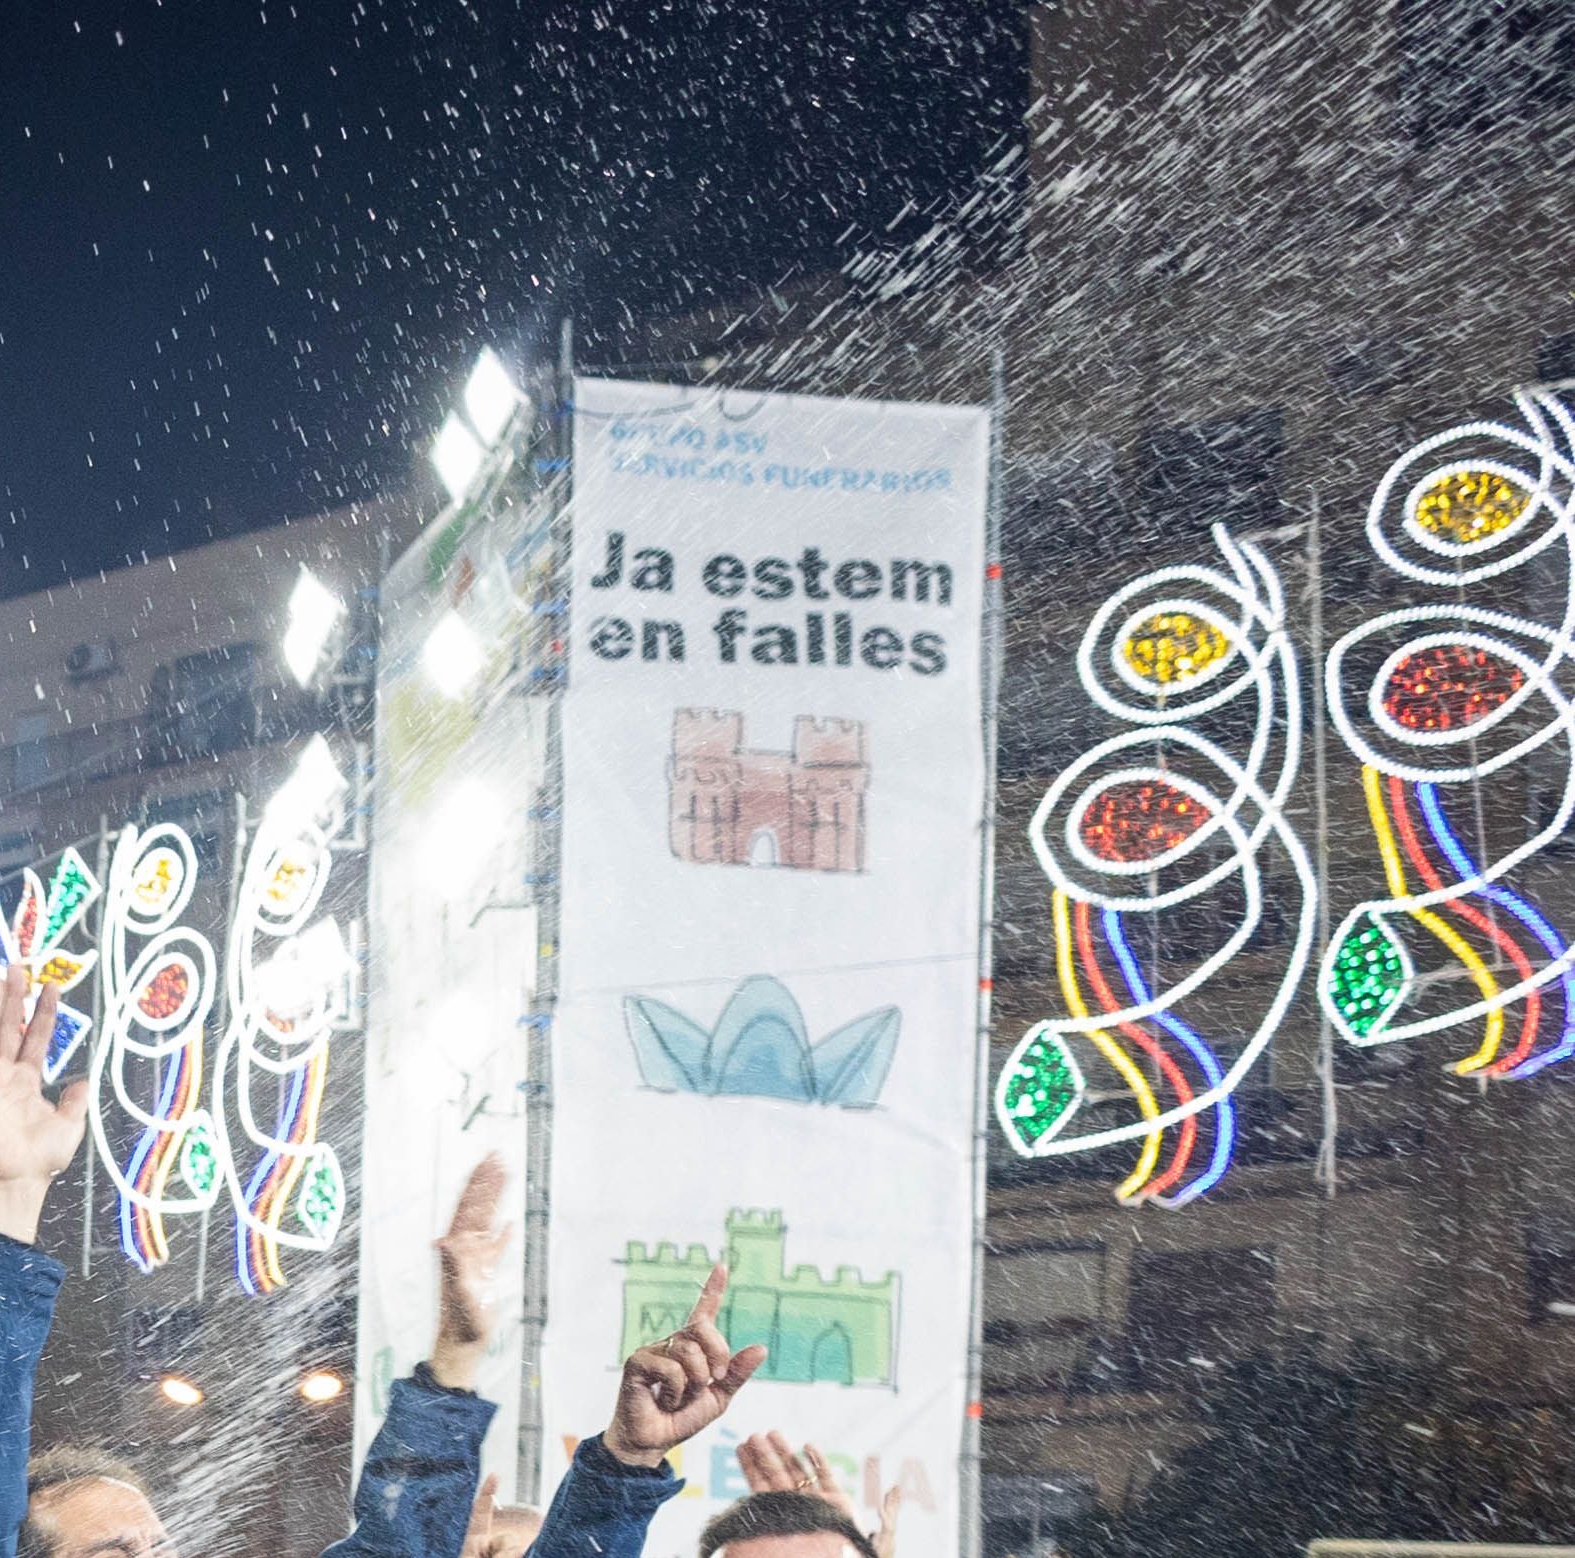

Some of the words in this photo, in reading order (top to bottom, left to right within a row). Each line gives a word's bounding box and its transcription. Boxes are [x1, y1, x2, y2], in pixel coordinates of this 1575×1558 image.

[589, 529, 676, 594] Ja
[701, 545, 954, 606] estem
[587, 614, 687, 664] en
[711, 607, 949, 676] falles
